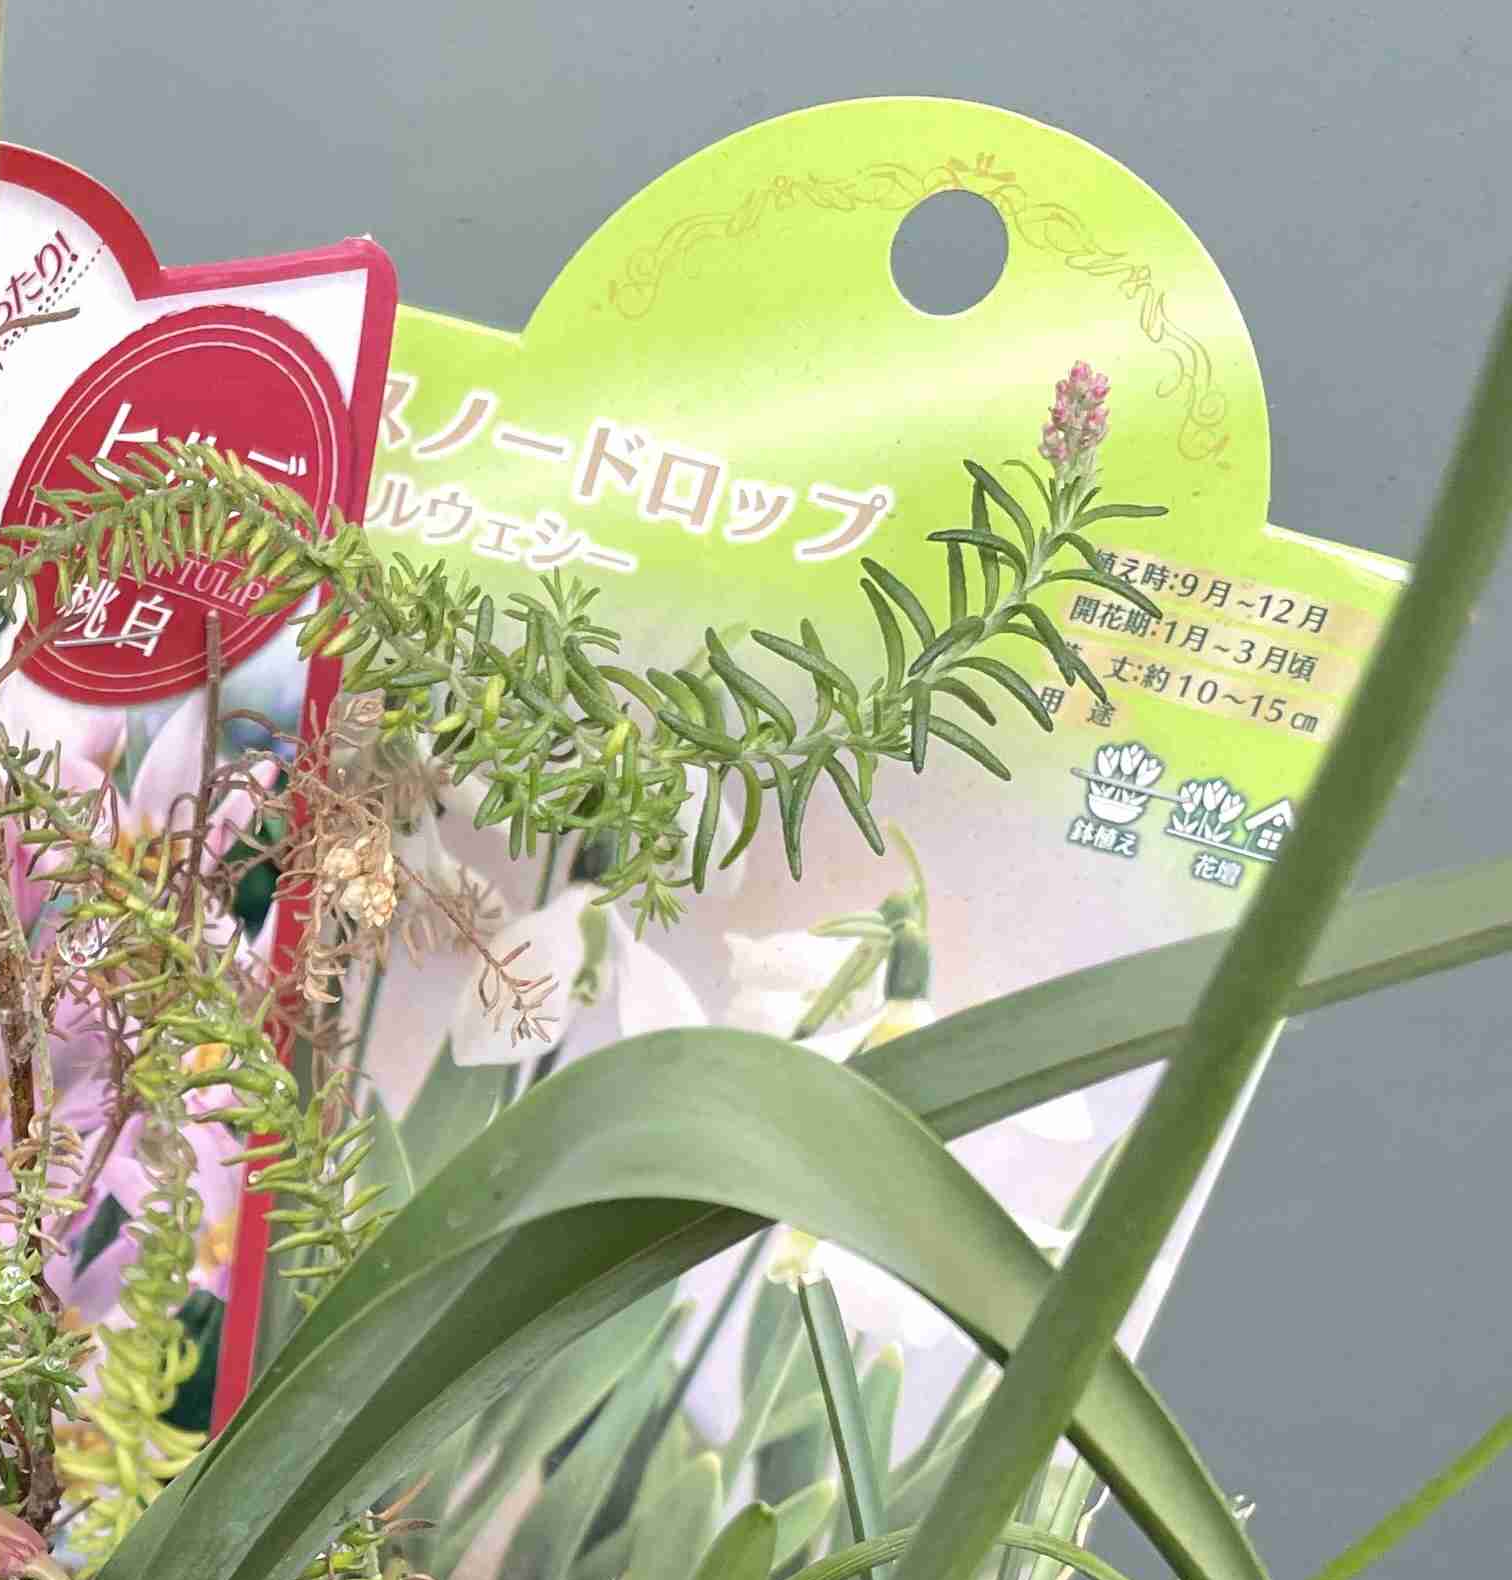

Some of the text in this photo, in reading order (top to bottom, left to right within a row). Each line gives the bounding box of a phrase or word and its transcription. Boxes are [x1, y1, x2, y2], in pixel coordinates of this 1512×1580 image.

[382, 378, 888, 556] スノードロップ
[1068, 817, 1141, 859] 鉢植え
[1192, 852, 1242, 889] 花壇
